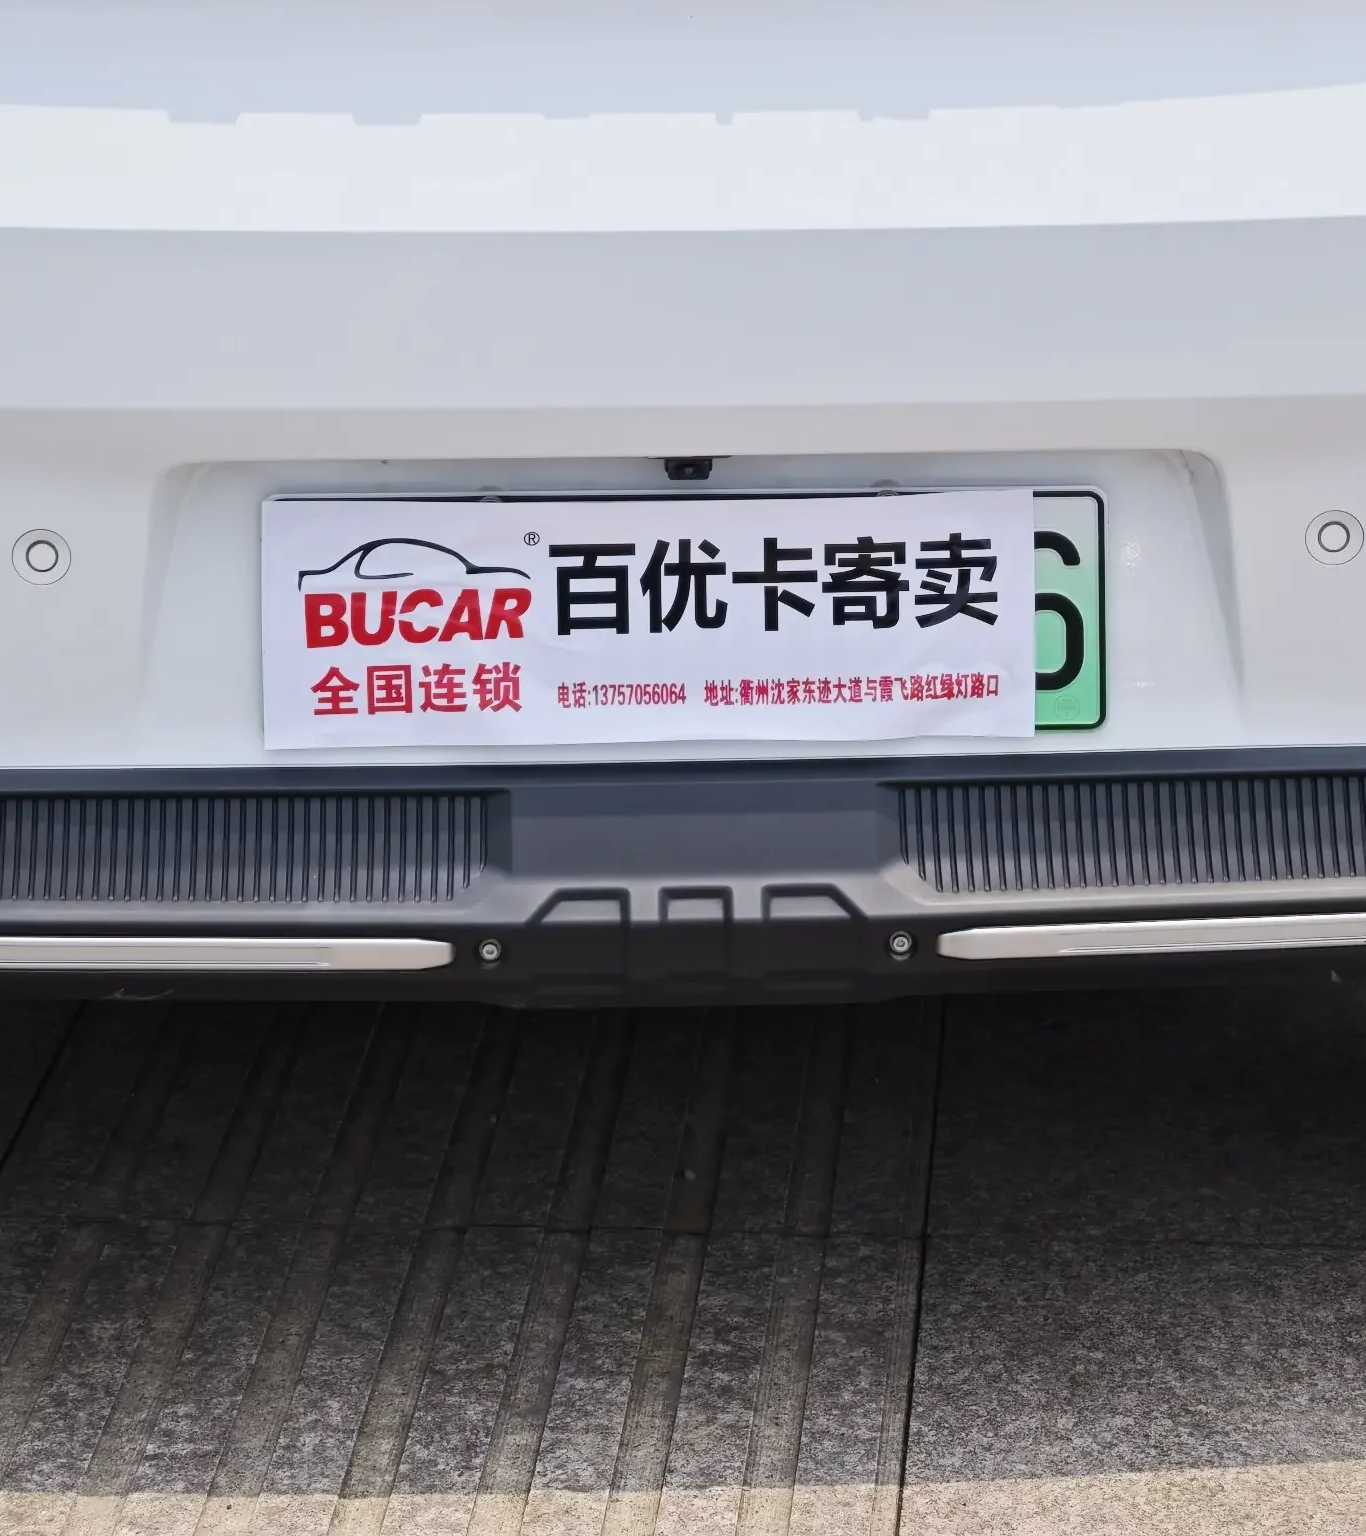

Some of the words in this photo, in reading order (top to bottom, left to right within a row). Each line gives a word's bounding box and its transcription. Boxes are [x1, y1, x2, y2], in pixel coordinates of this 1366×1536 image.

[548, 532, 998, 636] 百优卡寄卖
[304, 587, 532, 649] BUCAR
[310, 661, 523, 716] 全国连锁
